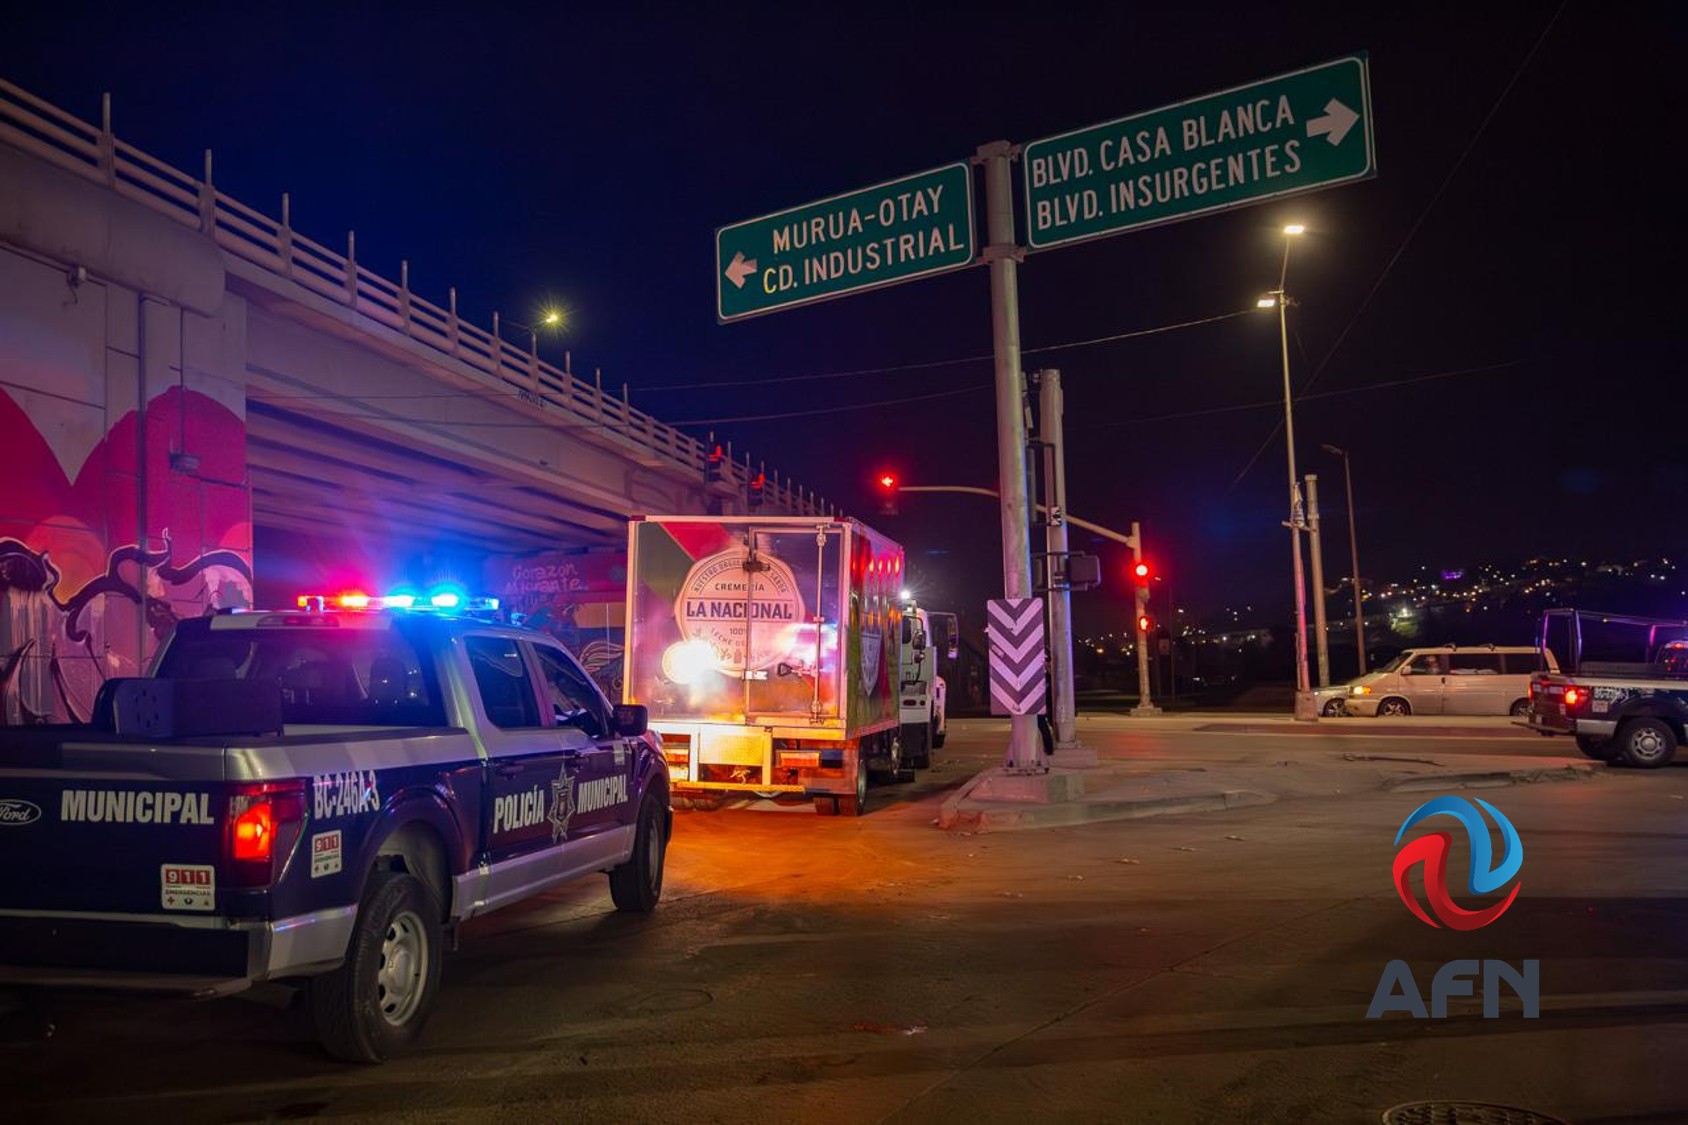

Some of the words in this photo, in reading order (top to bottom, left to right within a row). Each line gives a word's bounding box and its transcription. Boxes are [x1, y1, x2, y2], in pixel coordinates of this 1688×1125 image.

[1032, 147, 1093, 188] BLVD.
[1100, 126, 1171, 171] CASA
[1182, 94, 1295, 151] BLANCA
[1037, 189, 1103, 230] BLVD.
[1110, 139, 1300, 213] INSURGENTES
[773, 184, 944, 254] MURUA-OTAY
[763, 264, 798, 294] CD.
[804, 223, 965, 285] INDUSTRIAL
[694, 566, 718, 593] NUESTRO
[686, 601, 706, 618] LA
[710, 601, 792, 620] NACIONAL
[61, 790, 215, 825] MUNICIPAL
[313, 769, 380, 820] BC-246A-3
[493, 784, 545, 834] POLICÍA
[577, 774, 628, 814] MUNICIPAL
[168, 871, 207, 883] 911
